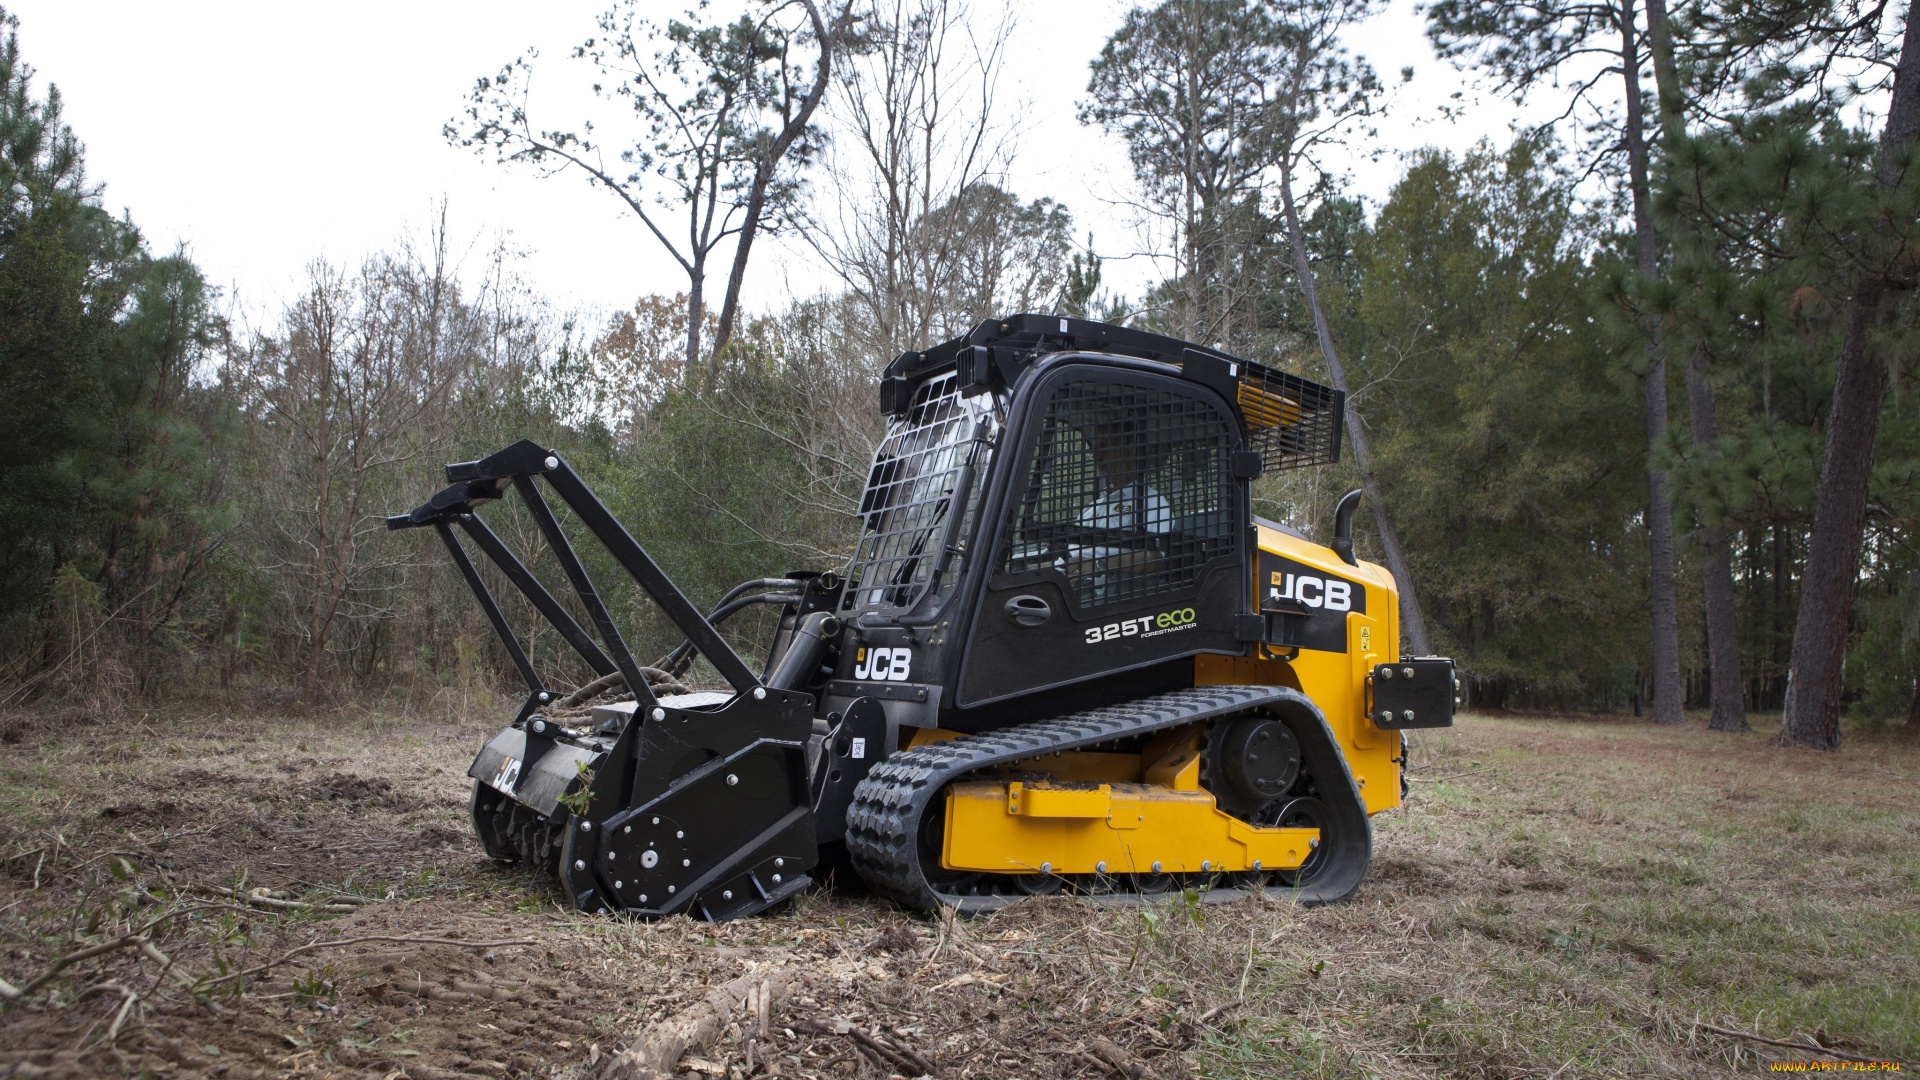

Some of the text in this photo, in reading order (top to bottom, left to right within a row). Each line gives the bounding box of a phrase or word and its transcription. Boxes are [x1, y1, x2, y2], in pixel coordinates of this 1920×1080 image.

[1270, 572, 1352, 612] JCB
[1140, 622, 1197, 639] FORESTMASTER
[855, 647, 912, 681] JCB
[492, 757, 521, 798] JC
